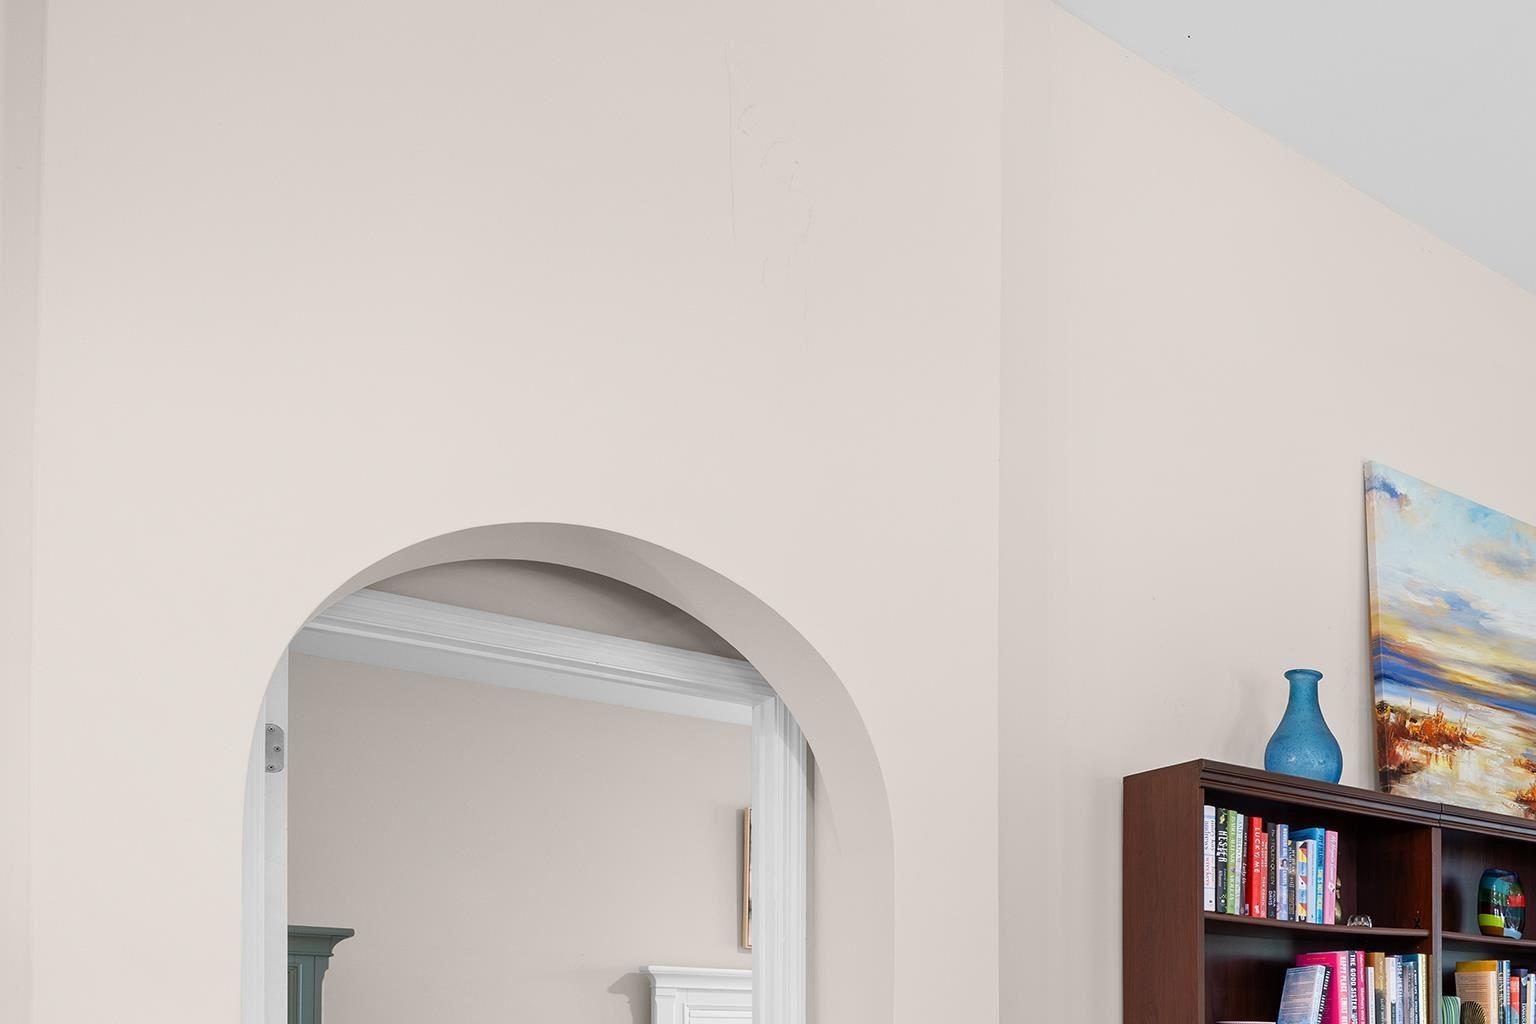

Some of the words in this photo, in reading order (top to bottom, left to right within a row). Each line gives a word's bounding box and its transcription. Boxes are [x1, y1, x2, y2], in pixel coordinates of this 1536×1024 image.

[1217, 830, 1228, 862] HESTER
[1254, 860, 1260, 873] ME
[1339, 956, 1347, 974] HAPPY
[1340, 976, 1348, 993] PLACE
[1340, 997, 1348, 1014] EMILY
